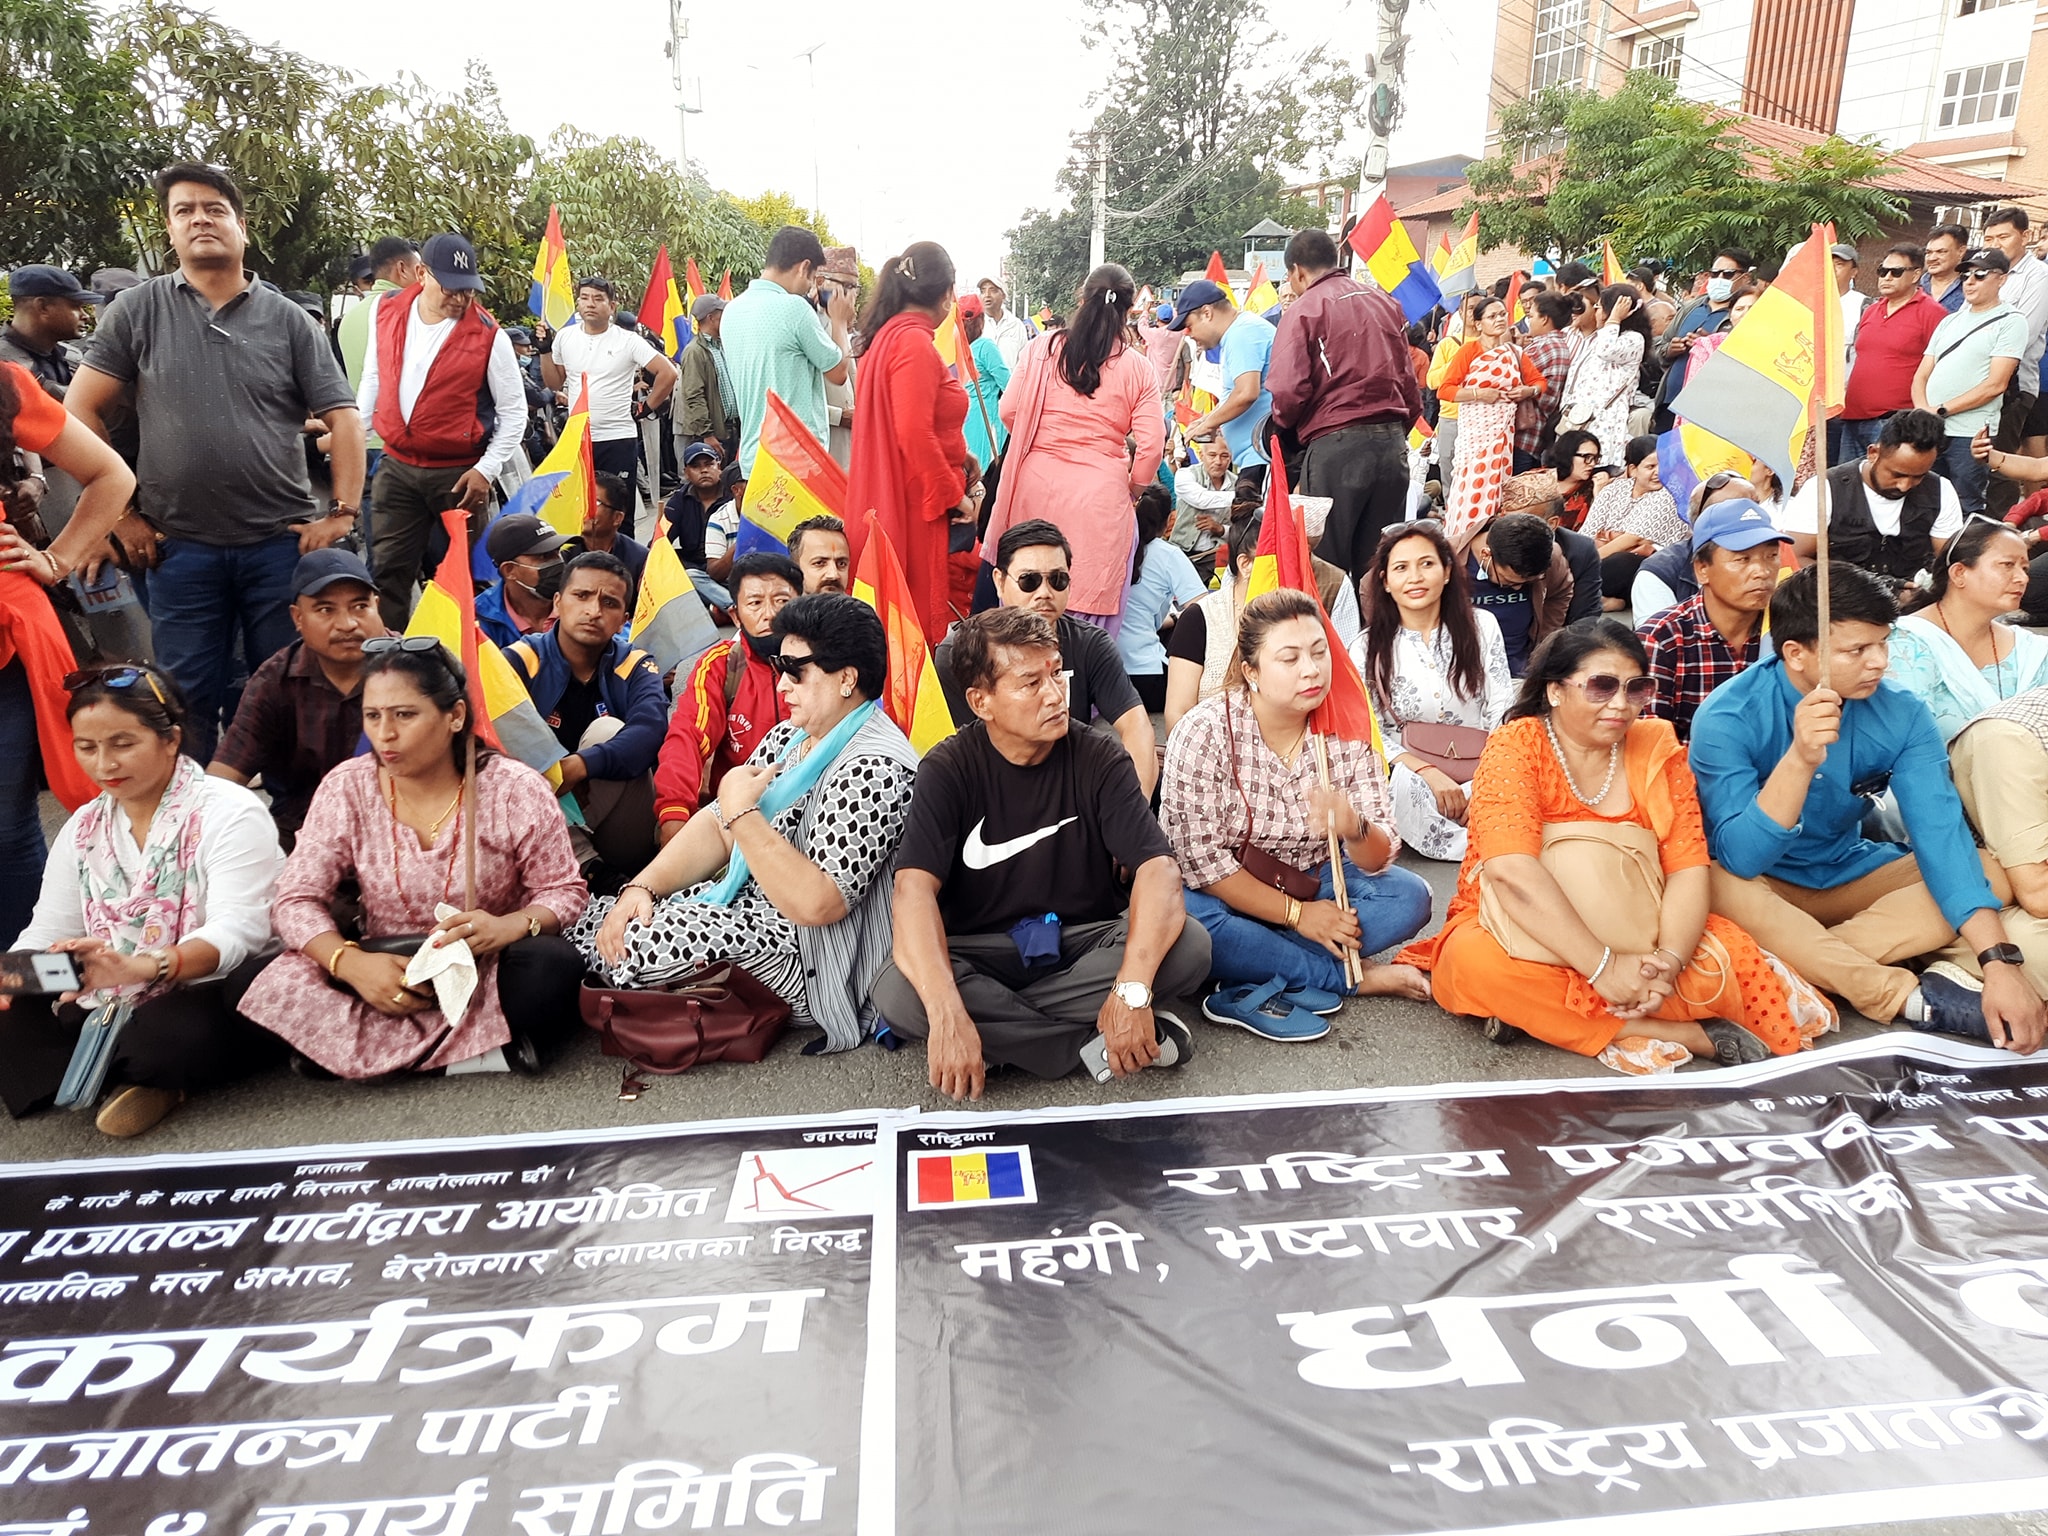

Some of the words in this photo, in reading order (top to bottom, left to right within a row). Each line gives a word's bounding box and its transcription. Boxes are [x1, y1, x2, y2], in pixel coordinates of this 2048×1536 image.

[22, 1217, 259, 1263] प्रजातन्त्र
[487, 1183, 717, 1232] आयोजित
[0, 1271, 139, 1304] ायनिक
[573, 1235, 754, 1270] लगायतका
[771, 1226, 866, 1256] विरुद्ध
[0, 1287, 826, 1403] कार्यक्रम
[1276, 1253, 1881, 1390] धर्ना
[416, 1385, 621, 1456] पार्टी
